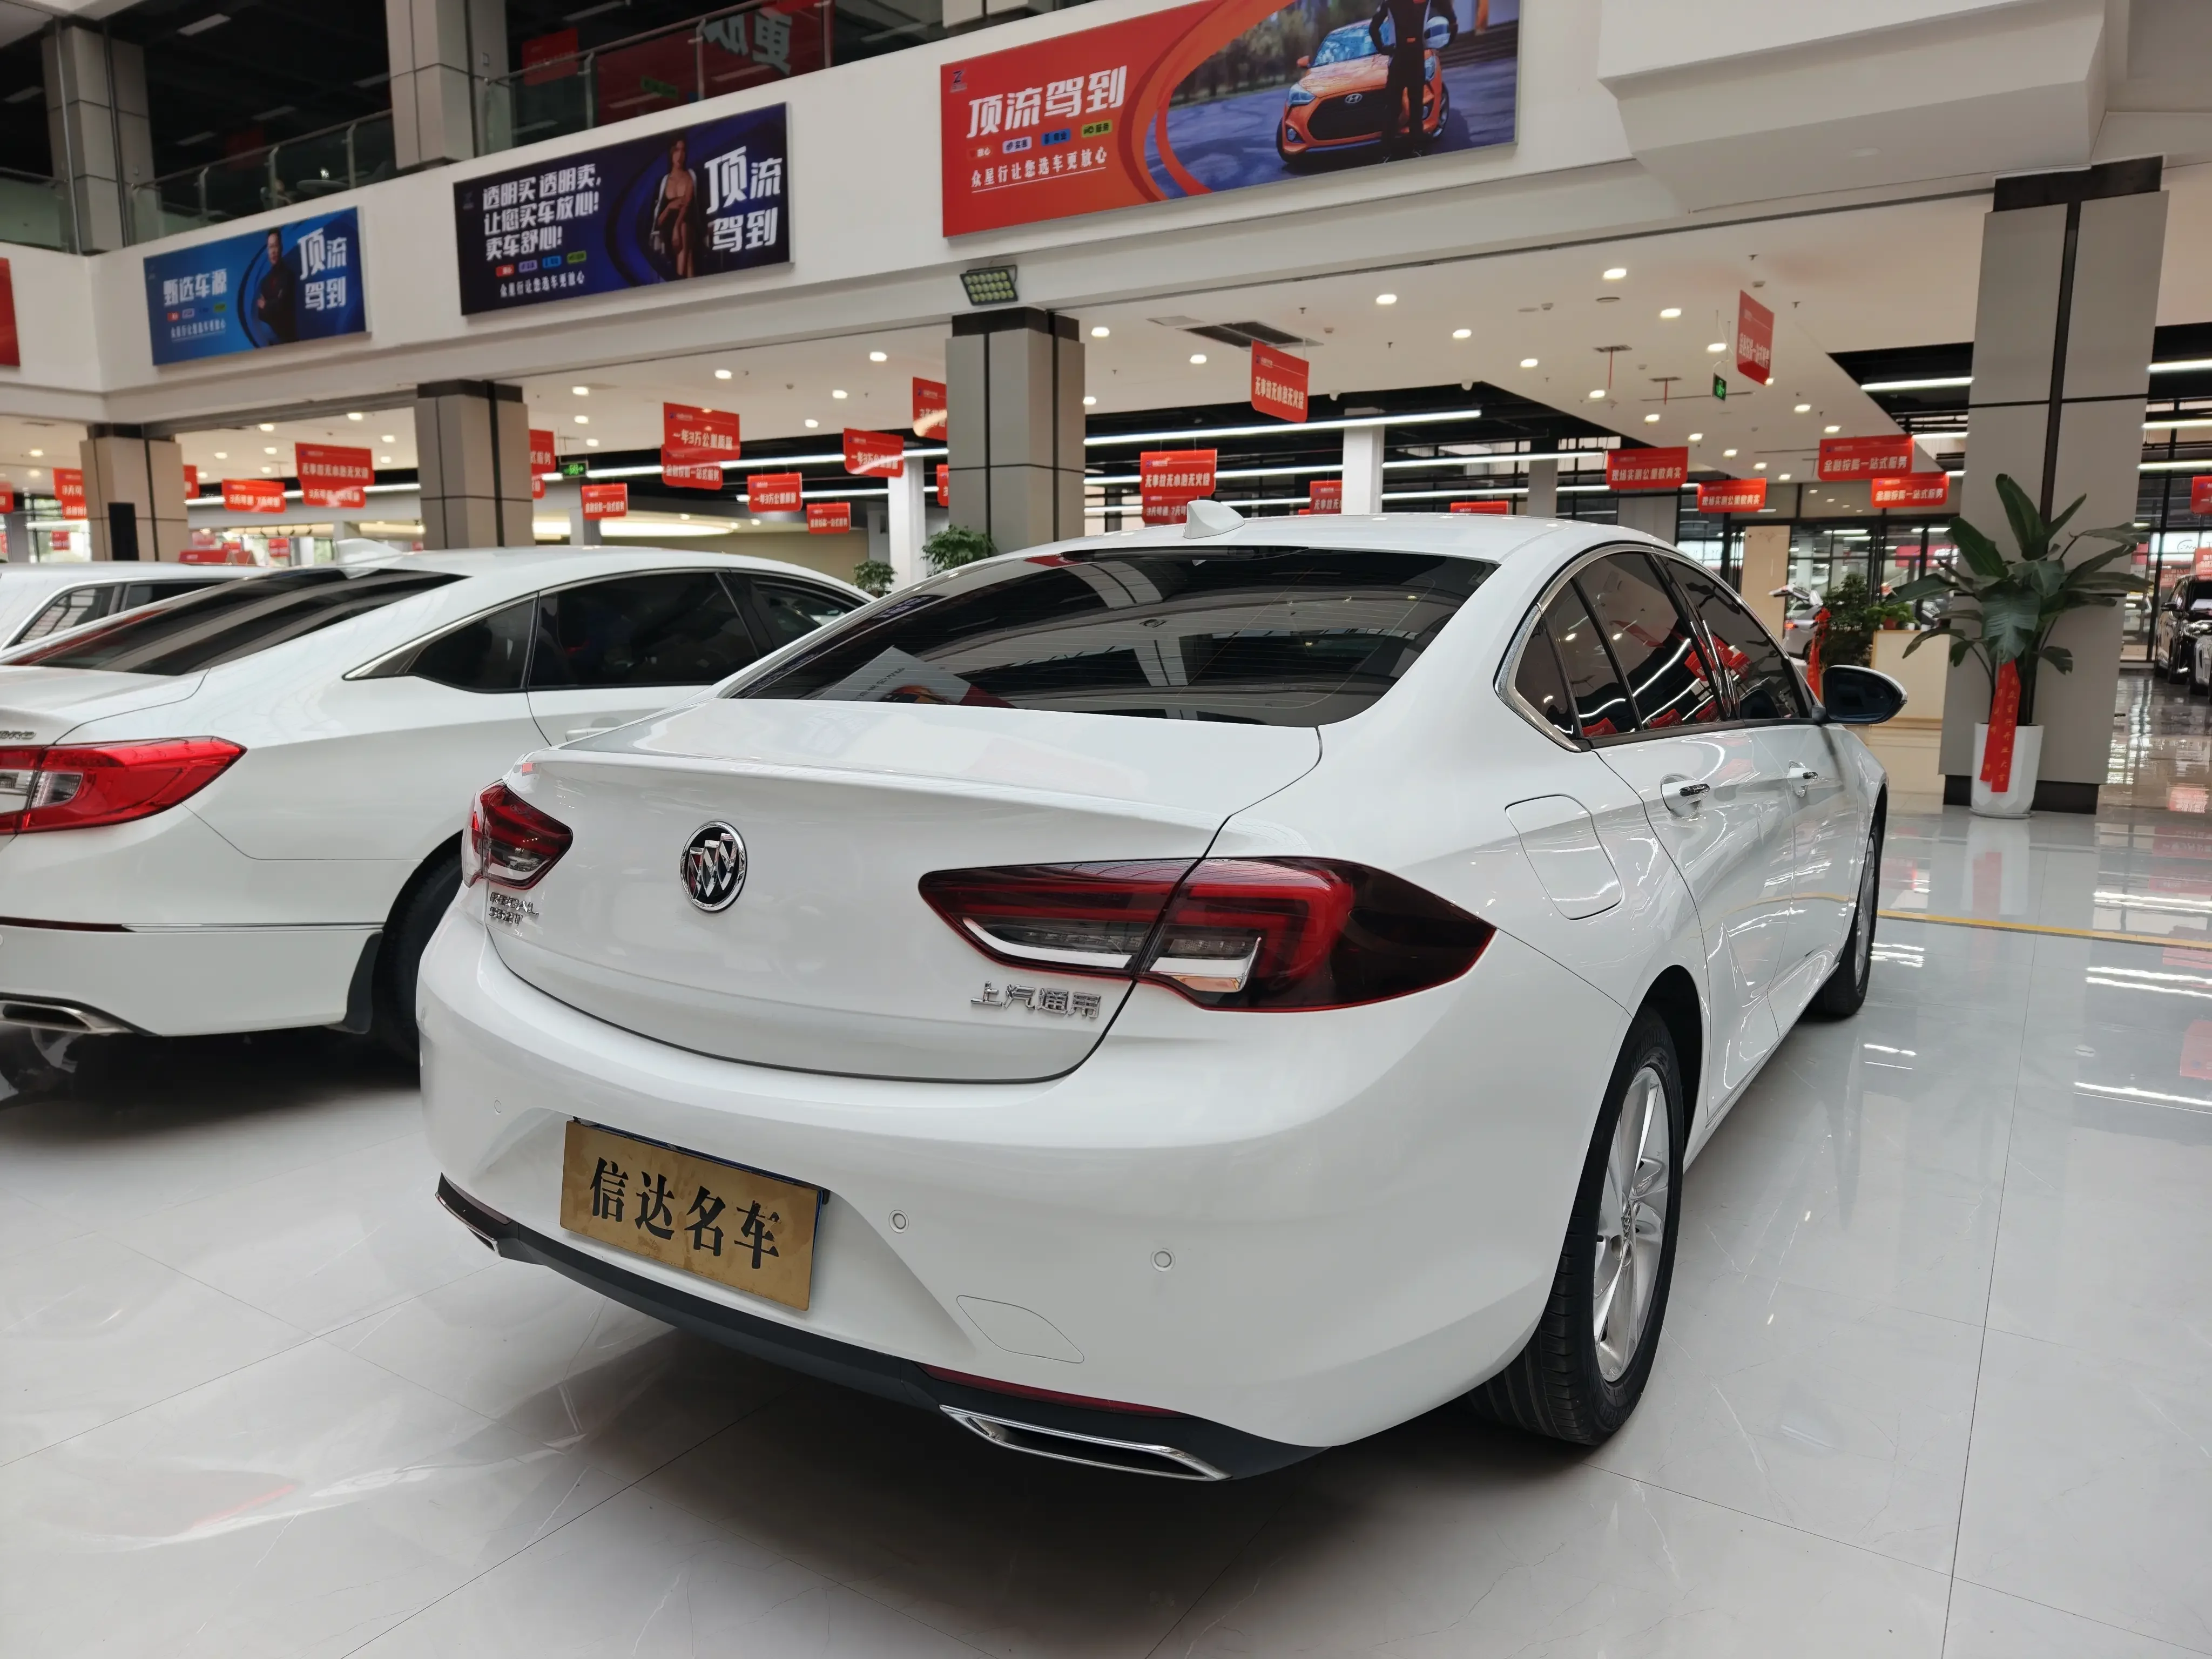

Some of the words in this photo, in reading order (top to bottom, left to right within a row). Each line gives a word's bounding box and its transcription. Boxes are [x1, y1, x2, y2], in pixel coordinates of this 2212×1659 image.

[966, 65, 1128, 138] 顶流驾到
[704, 145, 783, 214] 顶流
[972, 146, 1107, 187] 众星行让您选车更放心
[483, 177, 536, 211] 透明买
[712, 207, 778, 253] 驾到
[297, 227, 347, 280] 顶流
[163, 268, 227, 307] 甄选车源
[305, 276, 346, 311] 驾到
[1823, 456, 1907, 473] 金融按揭一站式服务
[490, 892, 539, 917] REGAL
[970, 981, 1102, 1019] 上汽通用
[589, 1157, 781, 1270] 信达名车
